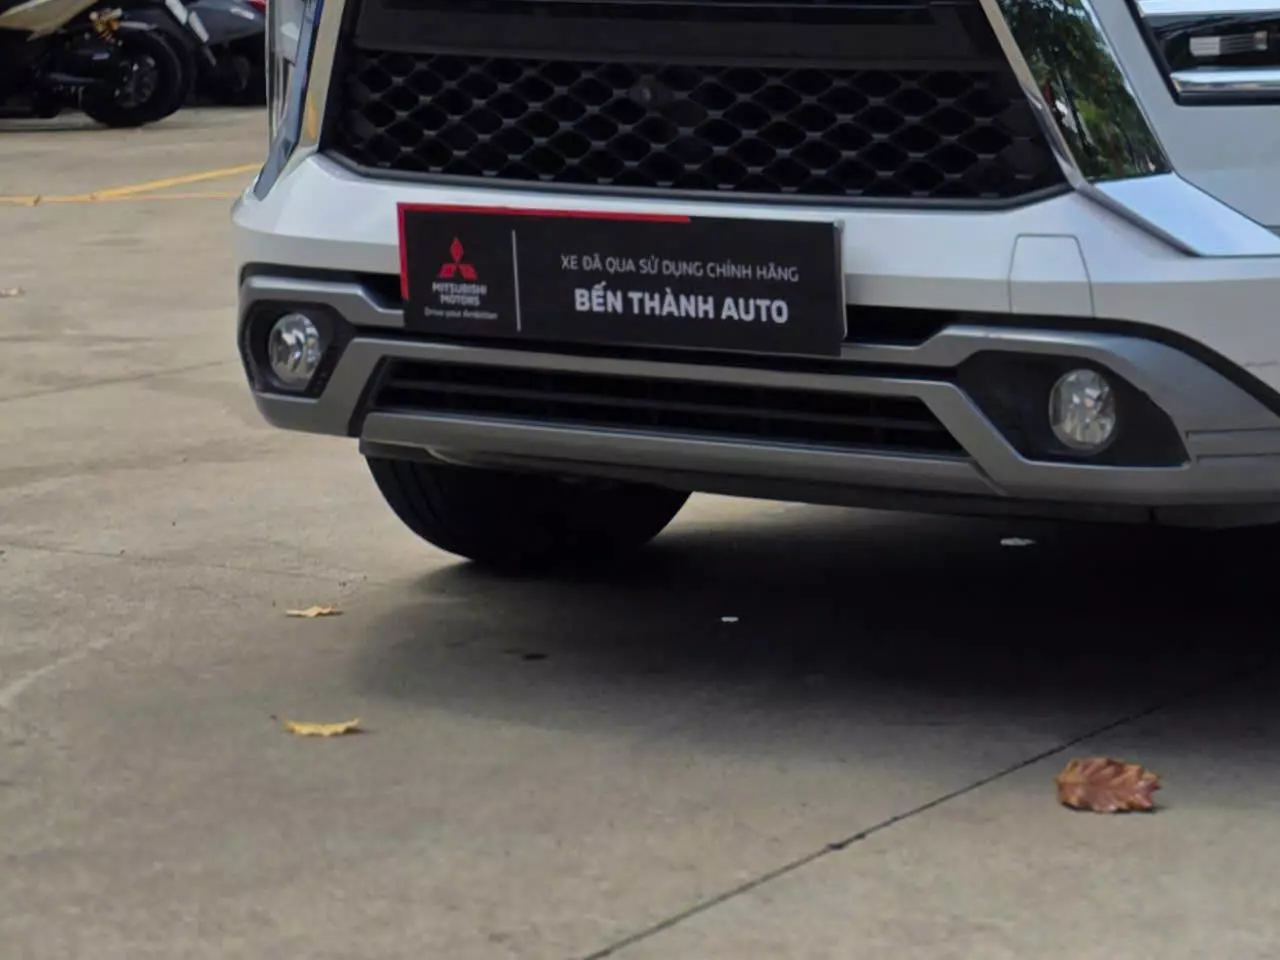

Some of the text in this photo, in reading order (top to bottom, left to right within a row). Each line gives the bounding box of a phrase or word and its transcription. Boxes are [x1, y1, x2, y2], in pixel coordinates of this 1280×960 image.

[560, 254, 579, 270] XE
[606, 256, 636, 274] QUA
[662, 260, 703, 278] DỤNG
[706, 260, 752, 279] CHÍNH
[574, 281, 788, 324] BẾN THÀNH AUTO
